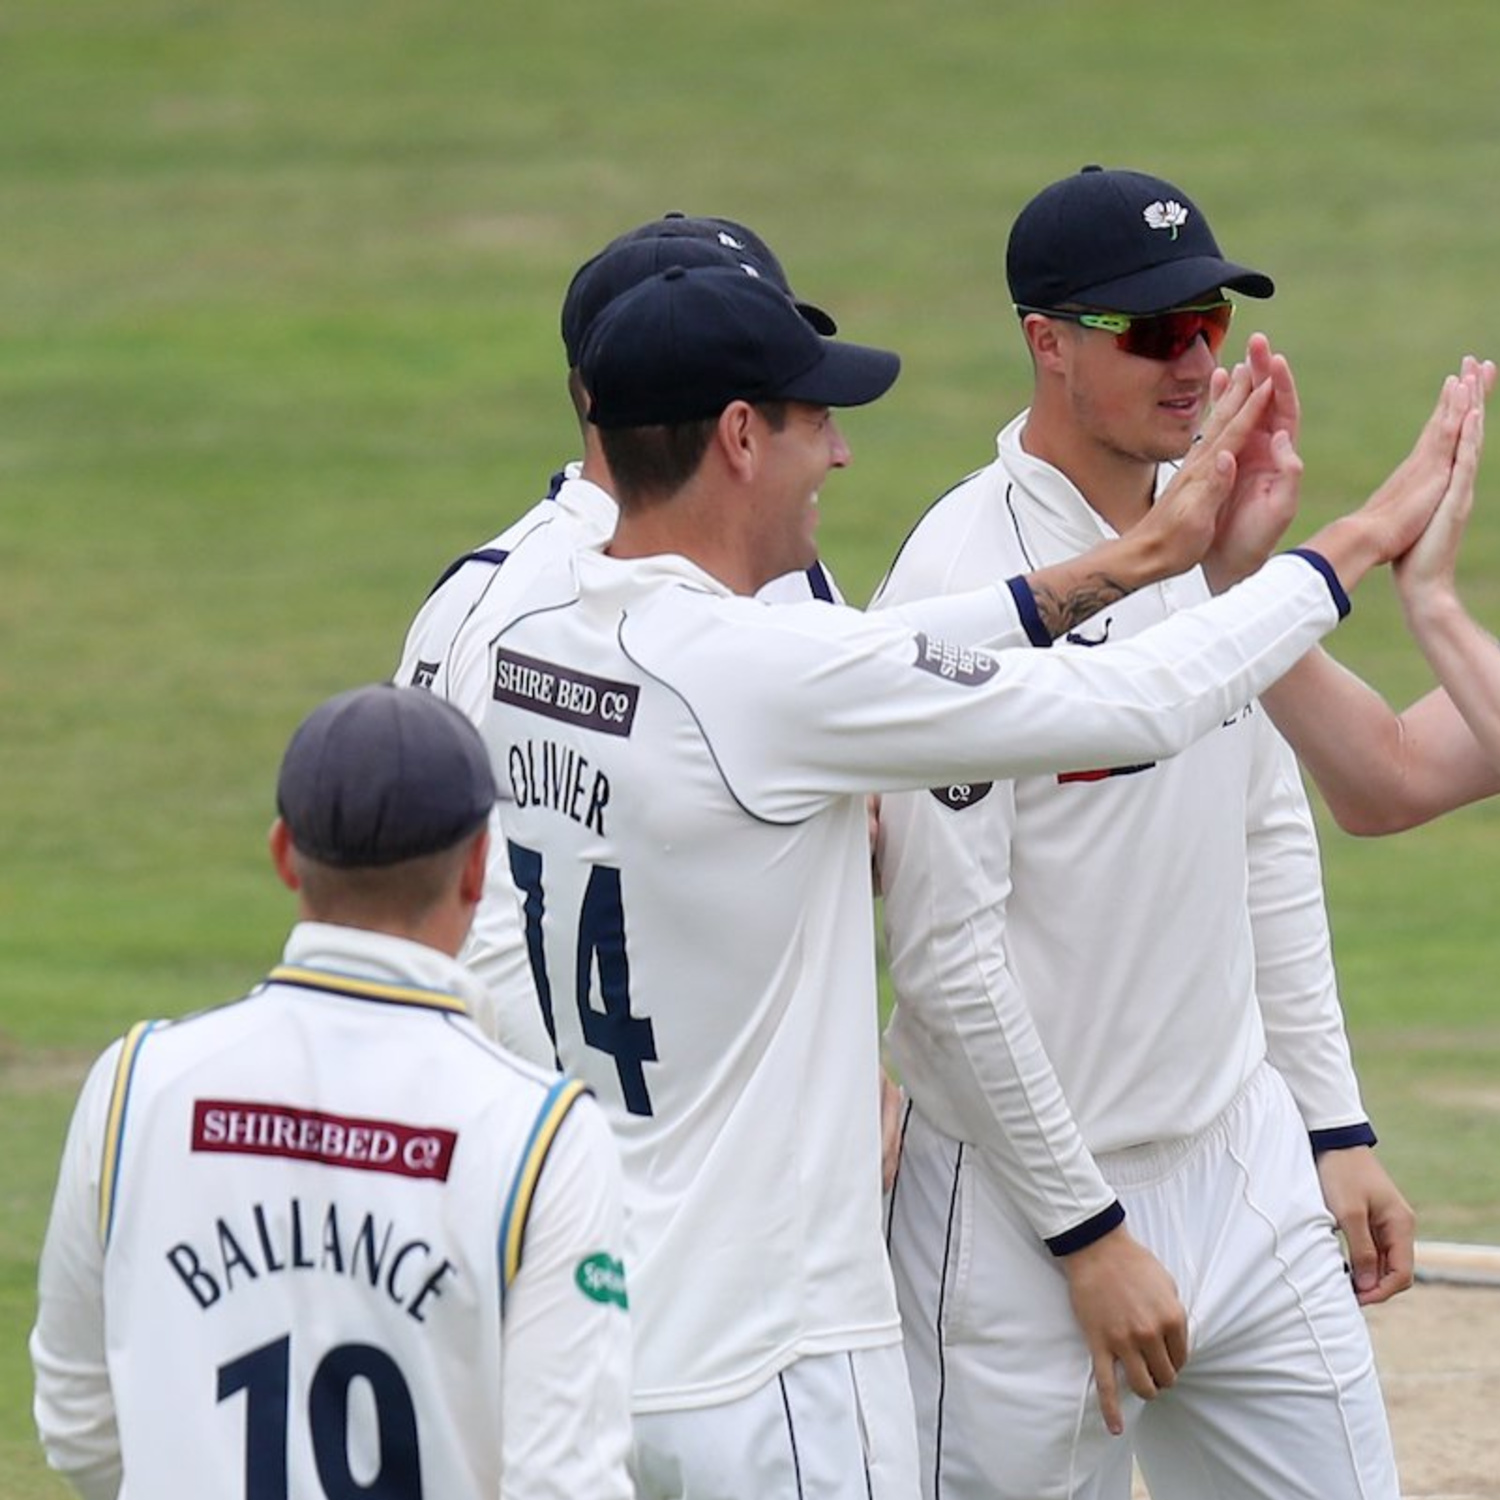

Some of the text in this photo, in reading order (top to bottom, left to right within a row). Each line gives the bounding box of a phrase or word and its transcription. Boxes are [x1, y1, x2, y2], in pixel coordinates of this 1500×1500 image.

[497, 659, 555, 704] SHIRE
[556, 678, 598, 715] BED
[508, 739, 611, 838] OLIVIER
[507, 838, 659, 1117] 14
[165, 1196, 458, 1323] BALLANCE
